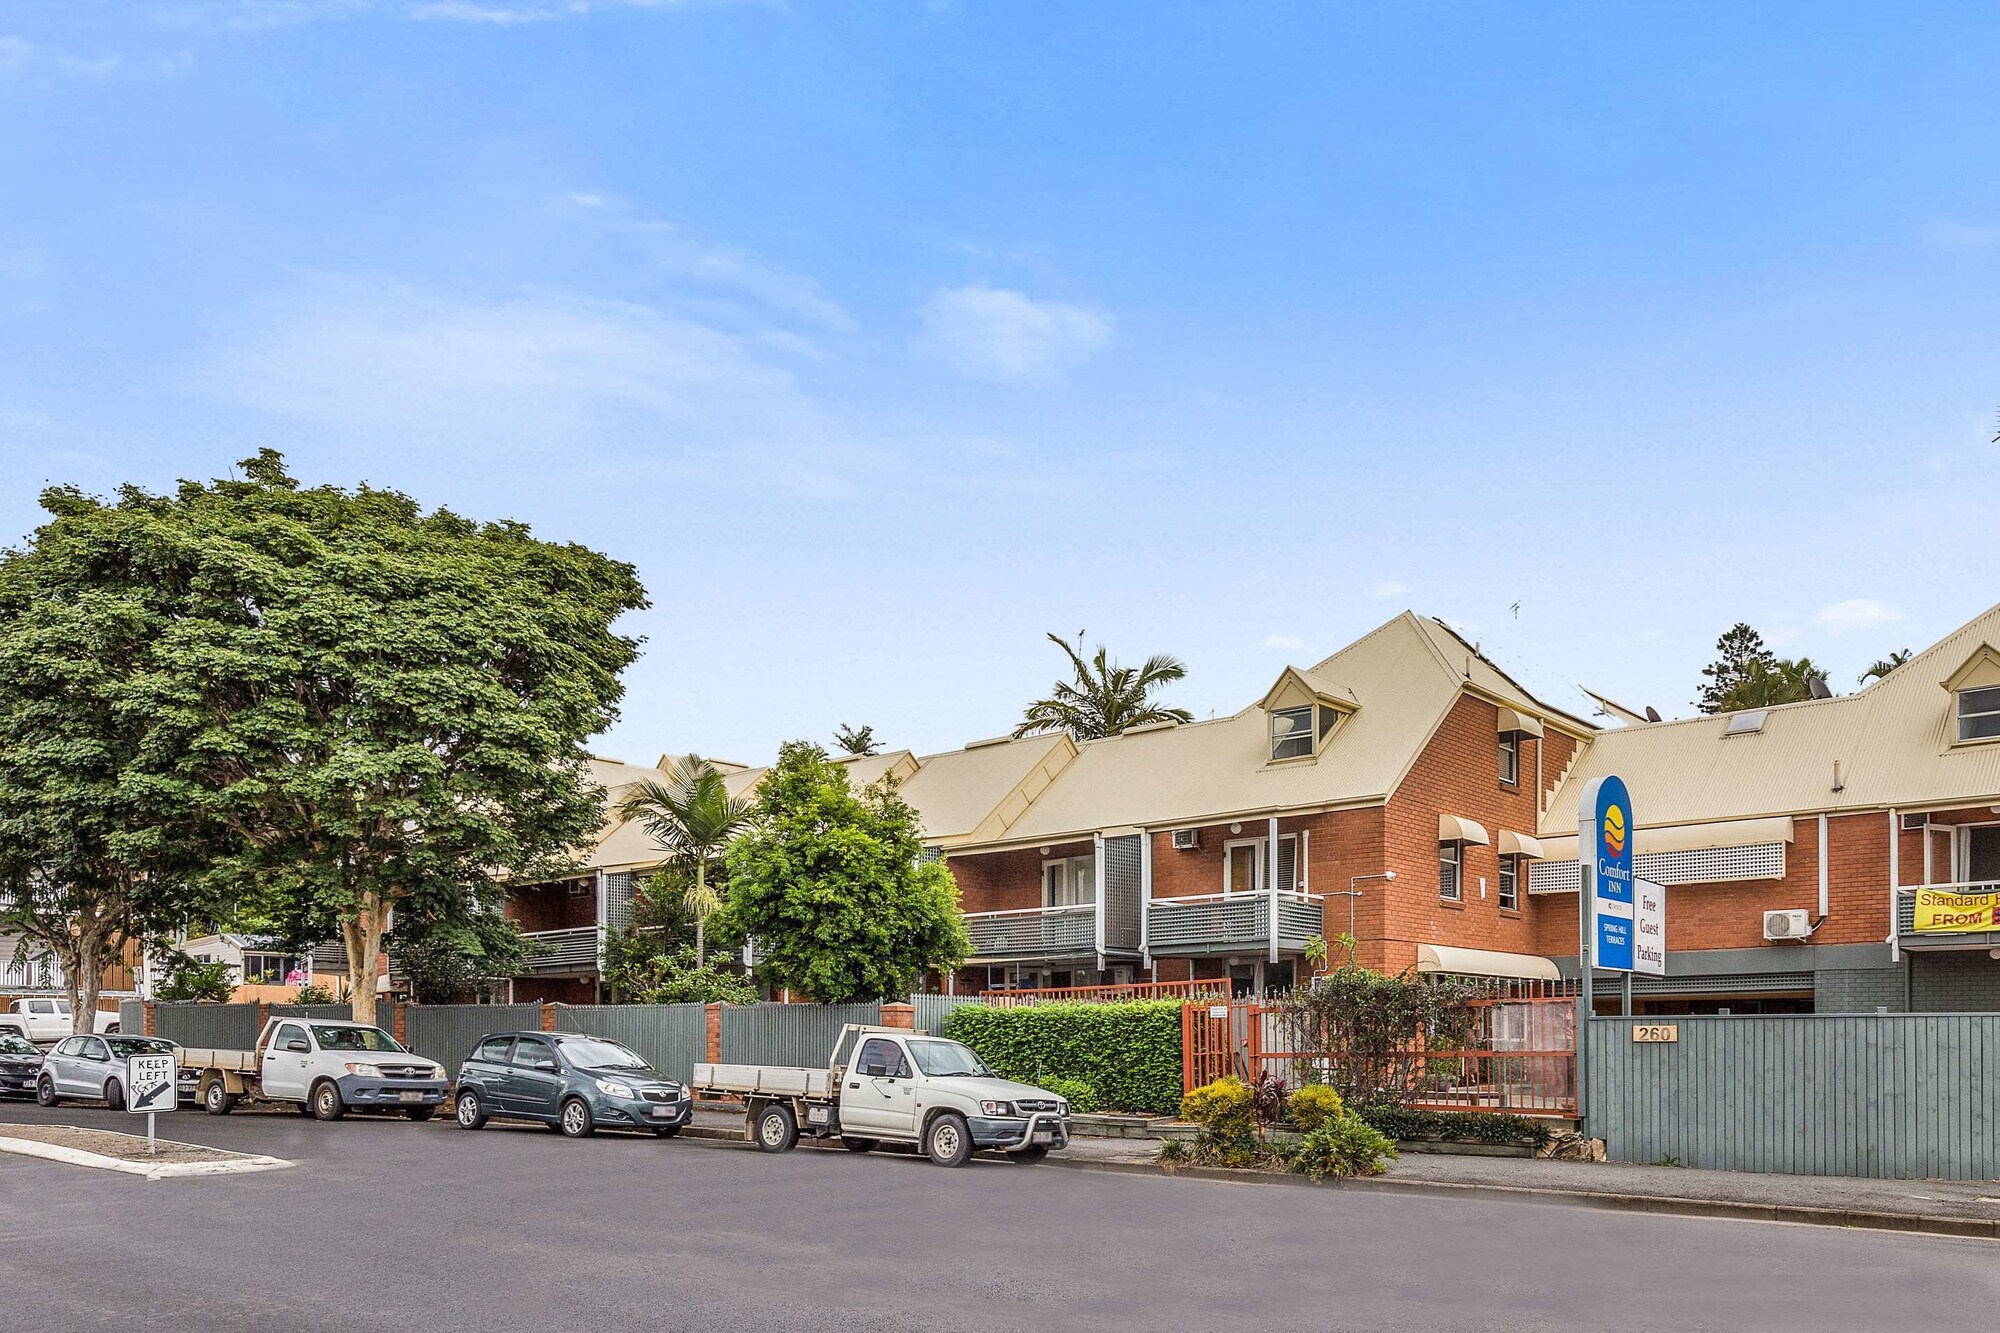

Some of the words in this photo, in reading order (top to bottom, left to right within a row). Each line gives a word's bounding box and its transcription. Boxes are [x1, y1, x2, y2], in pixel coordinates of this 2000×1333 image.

[1598, 857, 1630, 881] Comfort
[1608, 880, 1621, 893] INN
[1642, 895, 1656, 912] Free
[1920, 893, 1988, 906] Standard
[1932, 912, 1982, 925] FROM
[1603, 923, 1618, 933] SPRING
[1639, 918, 1659, 936] Guest
[1605, 935, 1625, 946] TERRACES
[1637, 944, 1662, 968] Parking
[1638, 1027, 1671, 1041] 260
[138, 1059, 169, 1070] KEEP
[139, 1071, 168, 1081] LEFT
